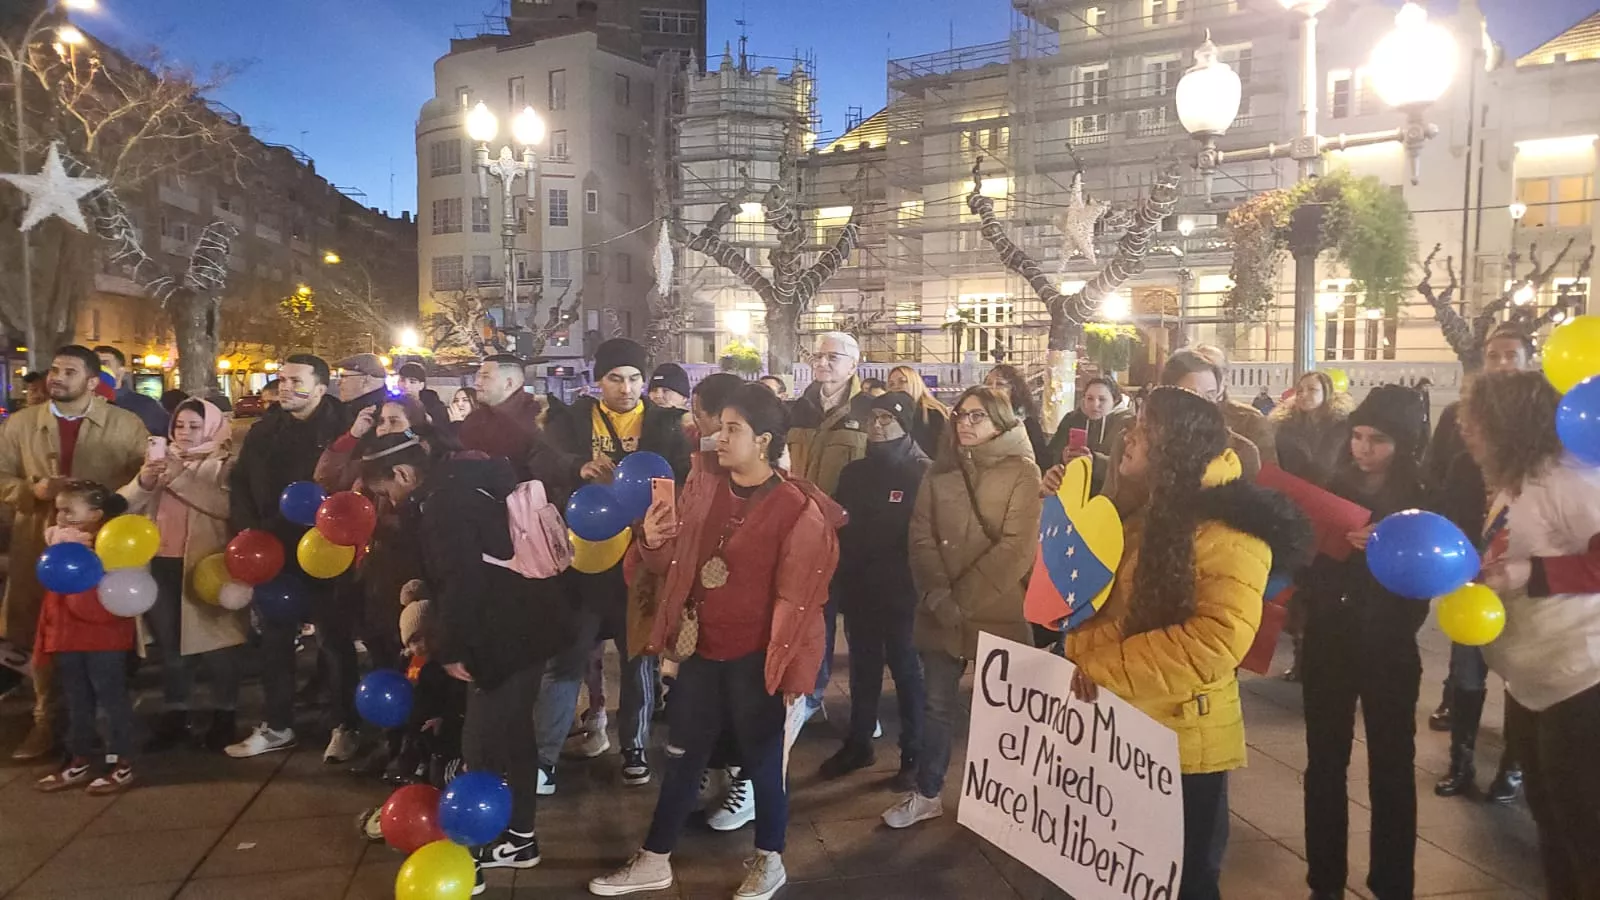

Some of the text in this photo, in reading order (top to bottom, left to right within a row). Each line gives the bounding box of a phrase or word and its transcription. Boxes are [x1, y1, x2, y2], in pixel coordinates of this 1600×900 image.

[980, 648, 1173, 796] Cuando Muere
[965, 757, 1028, 824] Nace
[1032, 785, 1057, 846] la
[998, 724, 1117, 831] el Miedo,
